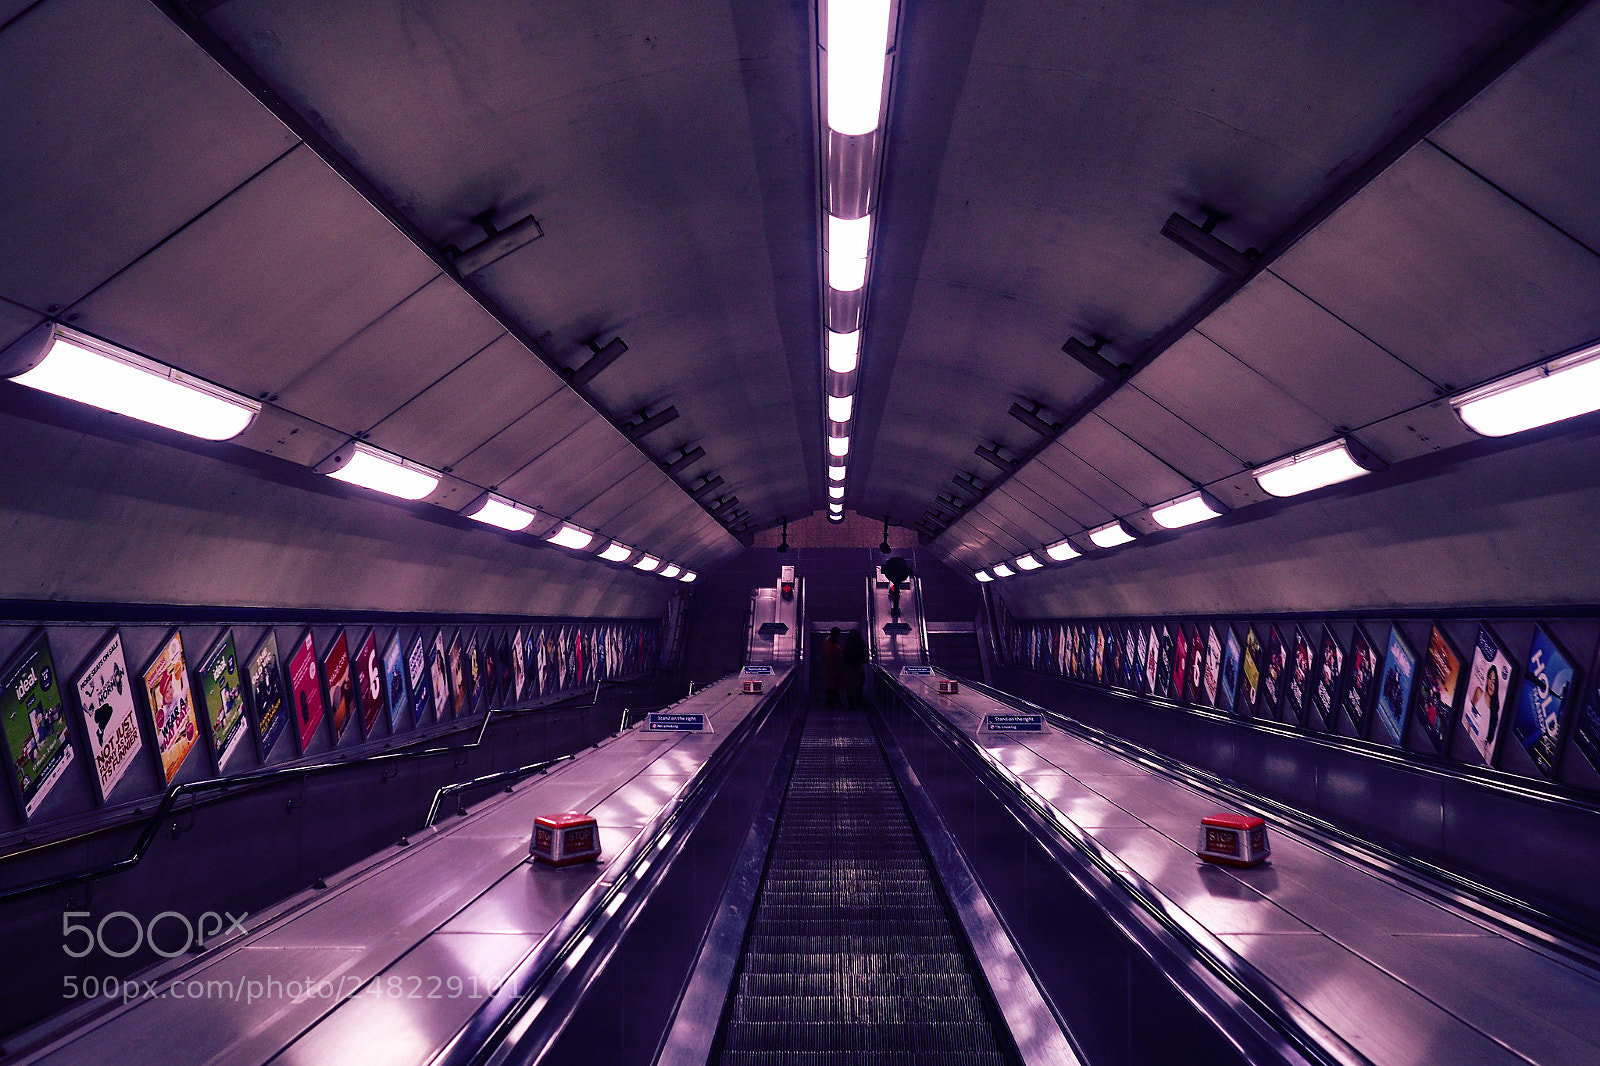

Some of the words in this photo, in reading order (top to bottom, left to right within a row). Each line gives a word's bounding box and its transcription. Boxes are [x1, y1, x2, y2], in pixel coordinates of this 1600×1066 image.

[15, 667, 38, 701] ideal
[80, 672, 91, 691] MORE
[91, 658, 103, 678] SEATS
[102, 651, 109, 663] ON
[108, 640, 118, 656] SALE
[1531, 649, 1559, 738] HOLD
[161, 706, 179, 738] WEAR
[179, 696, 186, 708] A
[162, 725, 175, 750] HAT
[175, 703, 188, 728] DAY
[96, 736, 115, 768] NOT
[113, 710, 134, 744] JUST
[99, 746, 117, 777] FUNNY
[116, 737, 124, 753] AS
[112, 730, 137, 772] FUNNIER
[568, 830, 590, 842] STOP
[1208, 831, 1234, 843] STOP
